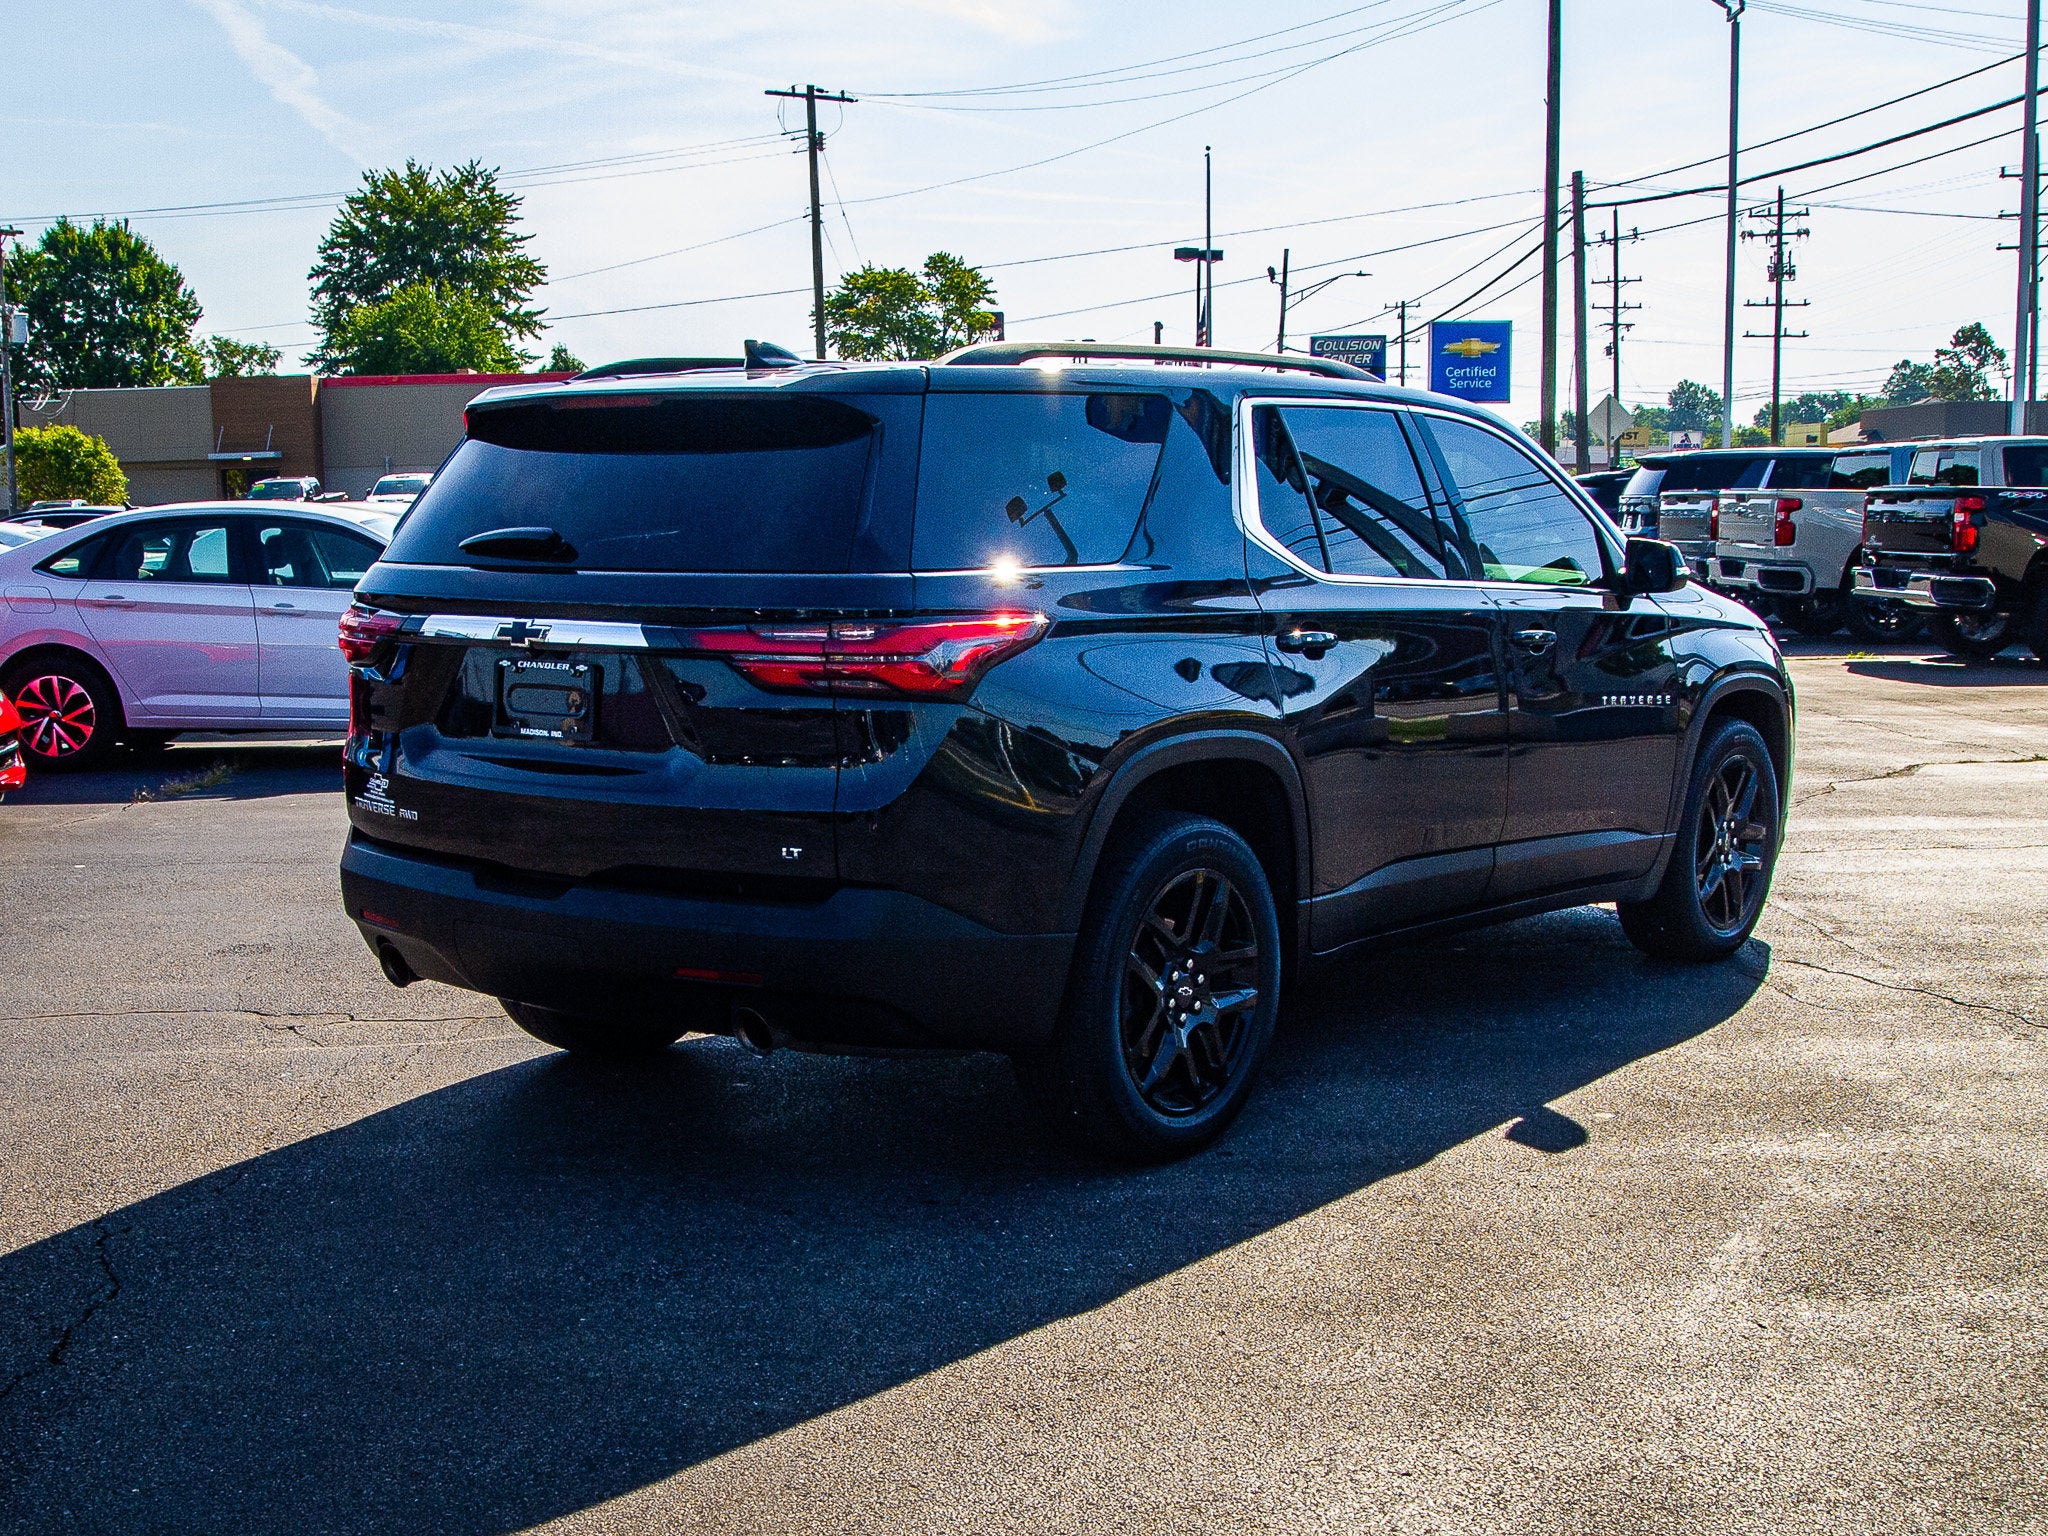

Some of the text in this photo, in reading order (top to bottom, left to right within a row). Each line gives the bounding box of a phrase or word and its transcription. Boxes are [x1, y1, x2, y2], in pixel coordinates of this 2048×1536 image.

[1314, 339, 1382, 352] COLLISION
[1445, 366, 1497, 378] Certified
[1449, 378, 1492, 389] Service
[517, 660, 570, 671] CHANDLER
[1602, 695, 1671, 705] TRAVERSE
[354, 796, 396, 817] TRAVERSE
[399, 808, 418, 821] AWD
[781, 847, 803, 859] LT
